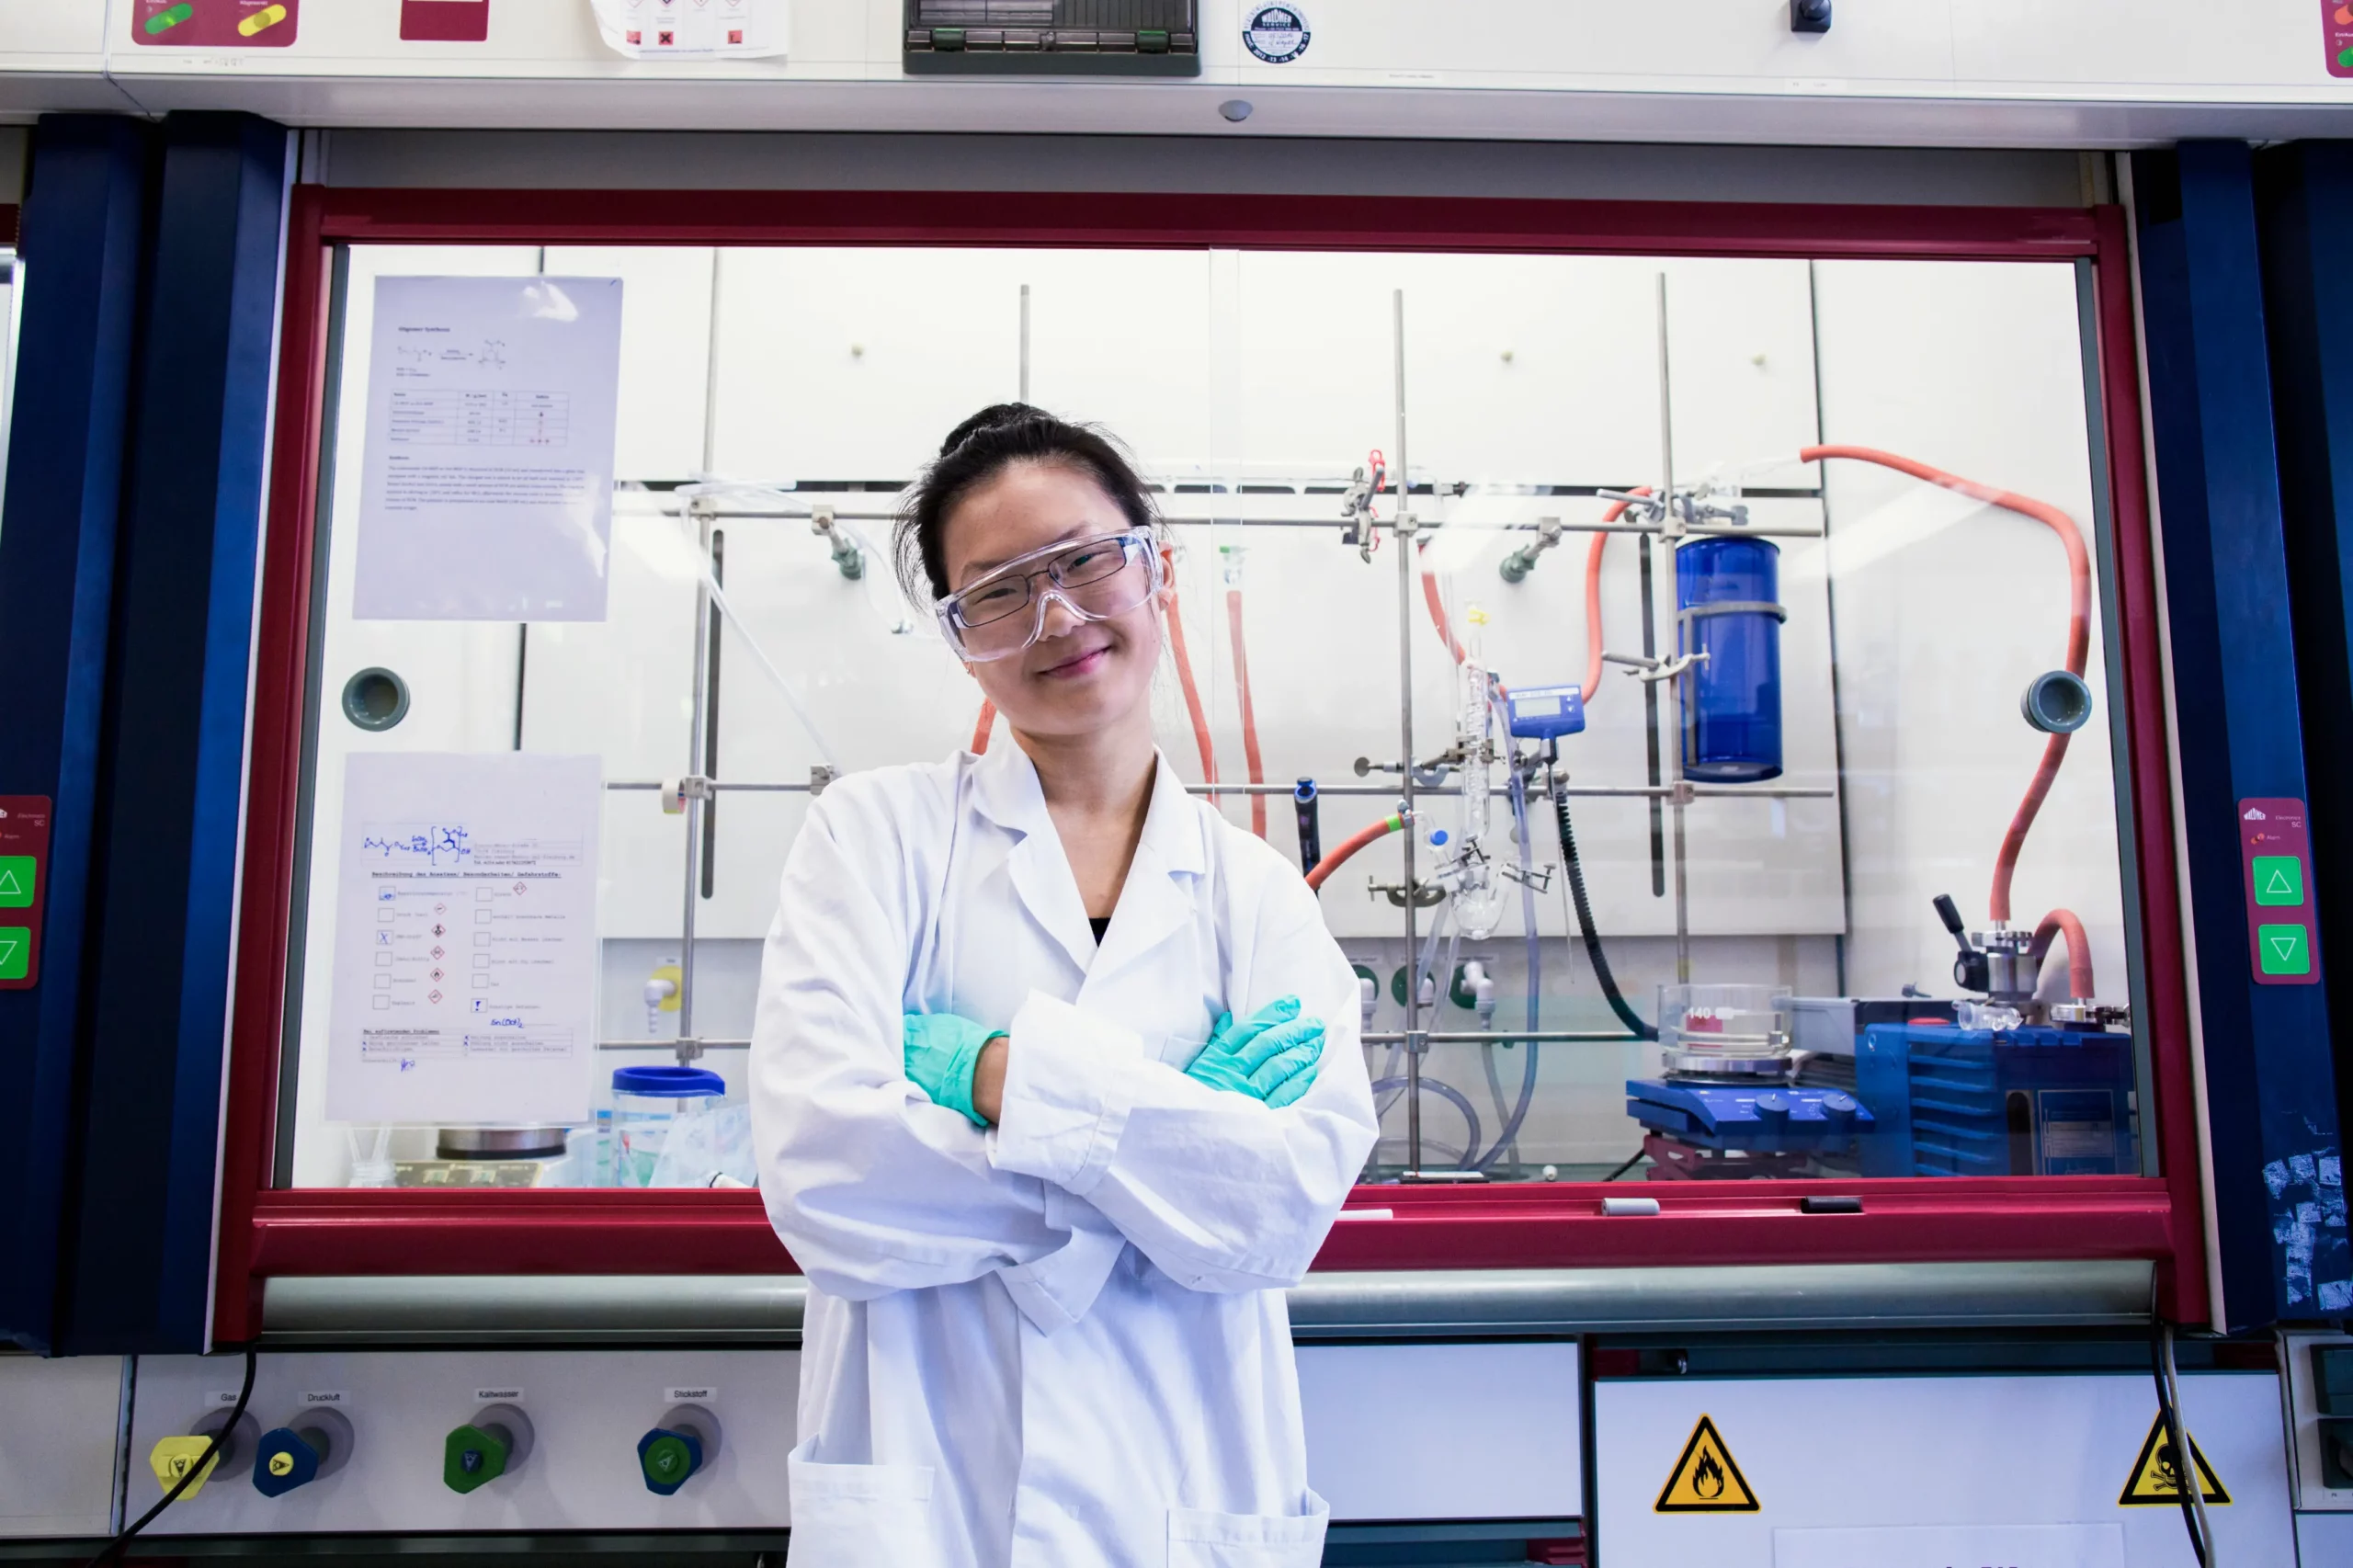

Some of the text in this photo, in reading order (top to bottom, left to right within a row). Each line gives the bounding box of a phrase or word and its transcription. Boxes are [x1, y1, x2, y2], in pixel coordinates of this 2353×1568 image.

[1262, 8, 1292, 22] WALDNER
[2244, 807, 2266, 821] WALDNER
[1688, 1007, 1711, 1019] 140
[221, 1393, 236, 1402] Gas
[308, 1393, 340, 1402] Druckluft
[674, 1390, 708, 1398] Stickstoff
